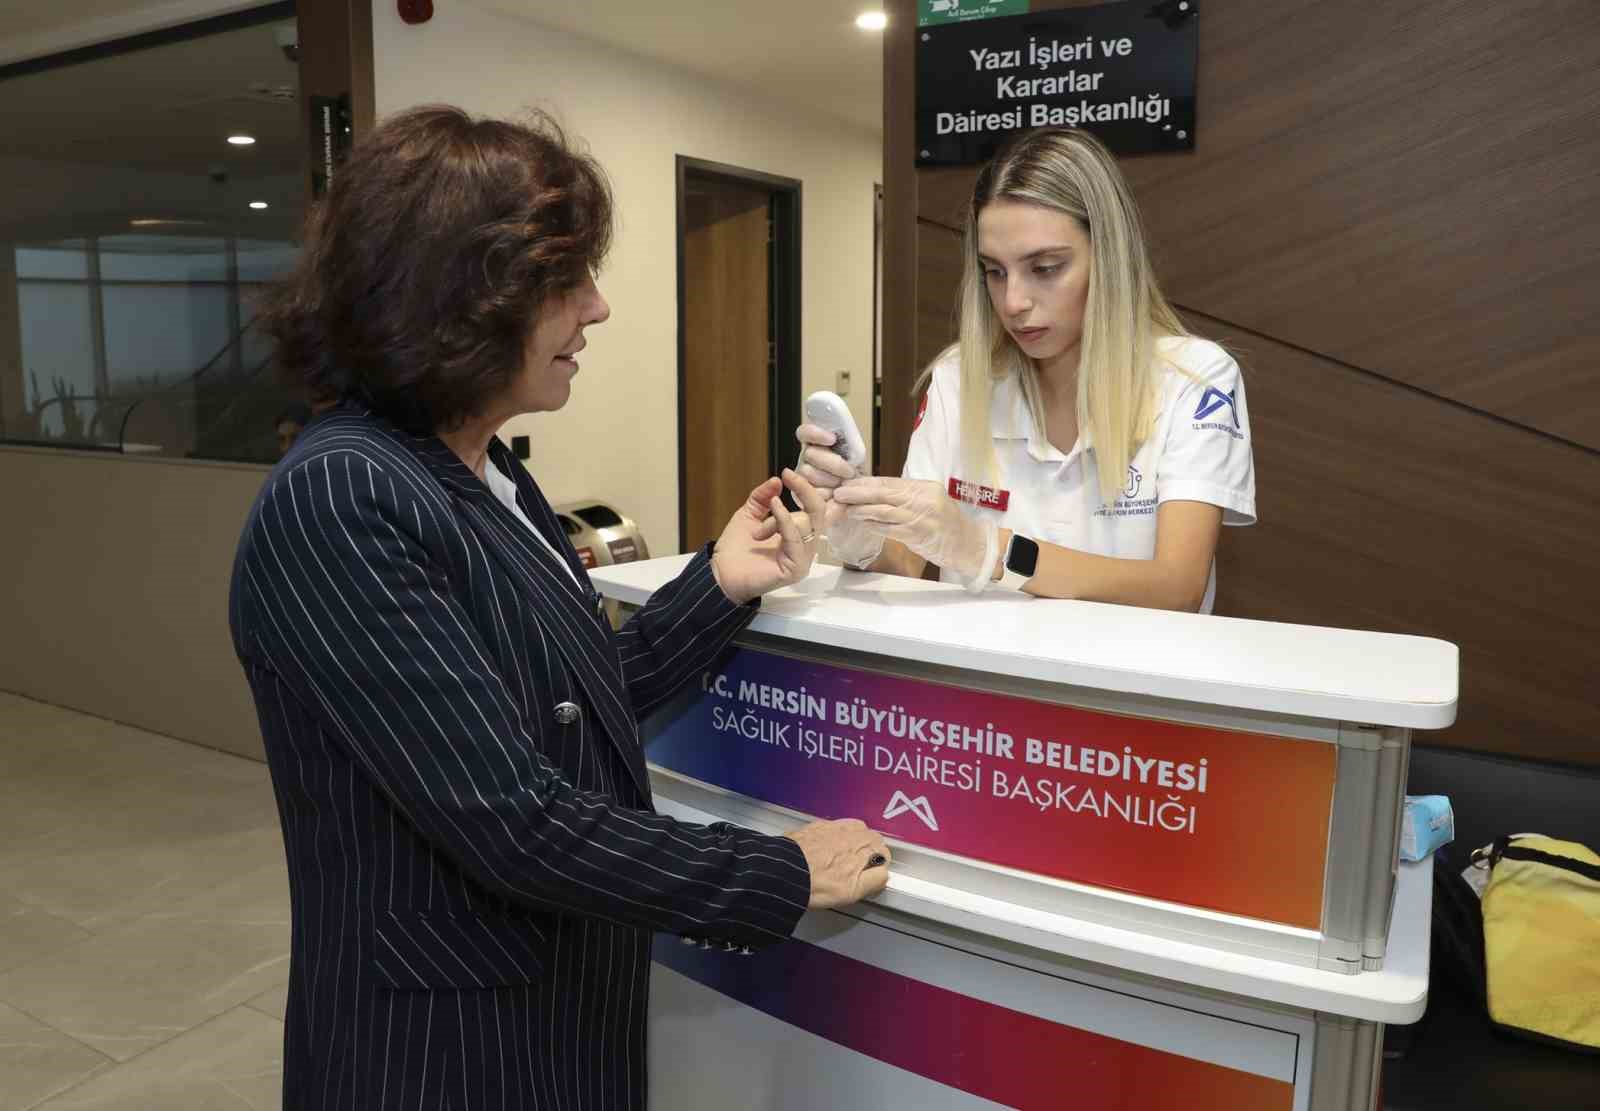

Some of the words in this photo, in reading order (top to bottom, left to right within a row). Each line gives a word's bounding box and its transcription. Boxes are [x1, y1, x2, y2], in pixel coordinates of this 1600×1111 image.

[969, 48, 1021, 71] Yazı
[1029, 37, 1093, 70] İşleri
[1101, 37, 1133, 57] ve
[997, 71, 1104, 99] Kararlar
[936, 106, 1022, 135] Dairesi
[1030, 93, 1170, 128] Başkanlığı
[738, 680, 826, 720] MERSİN
[834, 697, 1015, 760] BÜYÜKŞEHİR
[1025, 736, 1209, 793] BELEDİYESİ
[712, 706, 791, 748] SAĞLIK
[798, 720, 864, 767] İŞLERİ
[873, 747, 982, 792] DAİRESİ
[992, 770, 1196, 834] BAŞKANLIĞI
